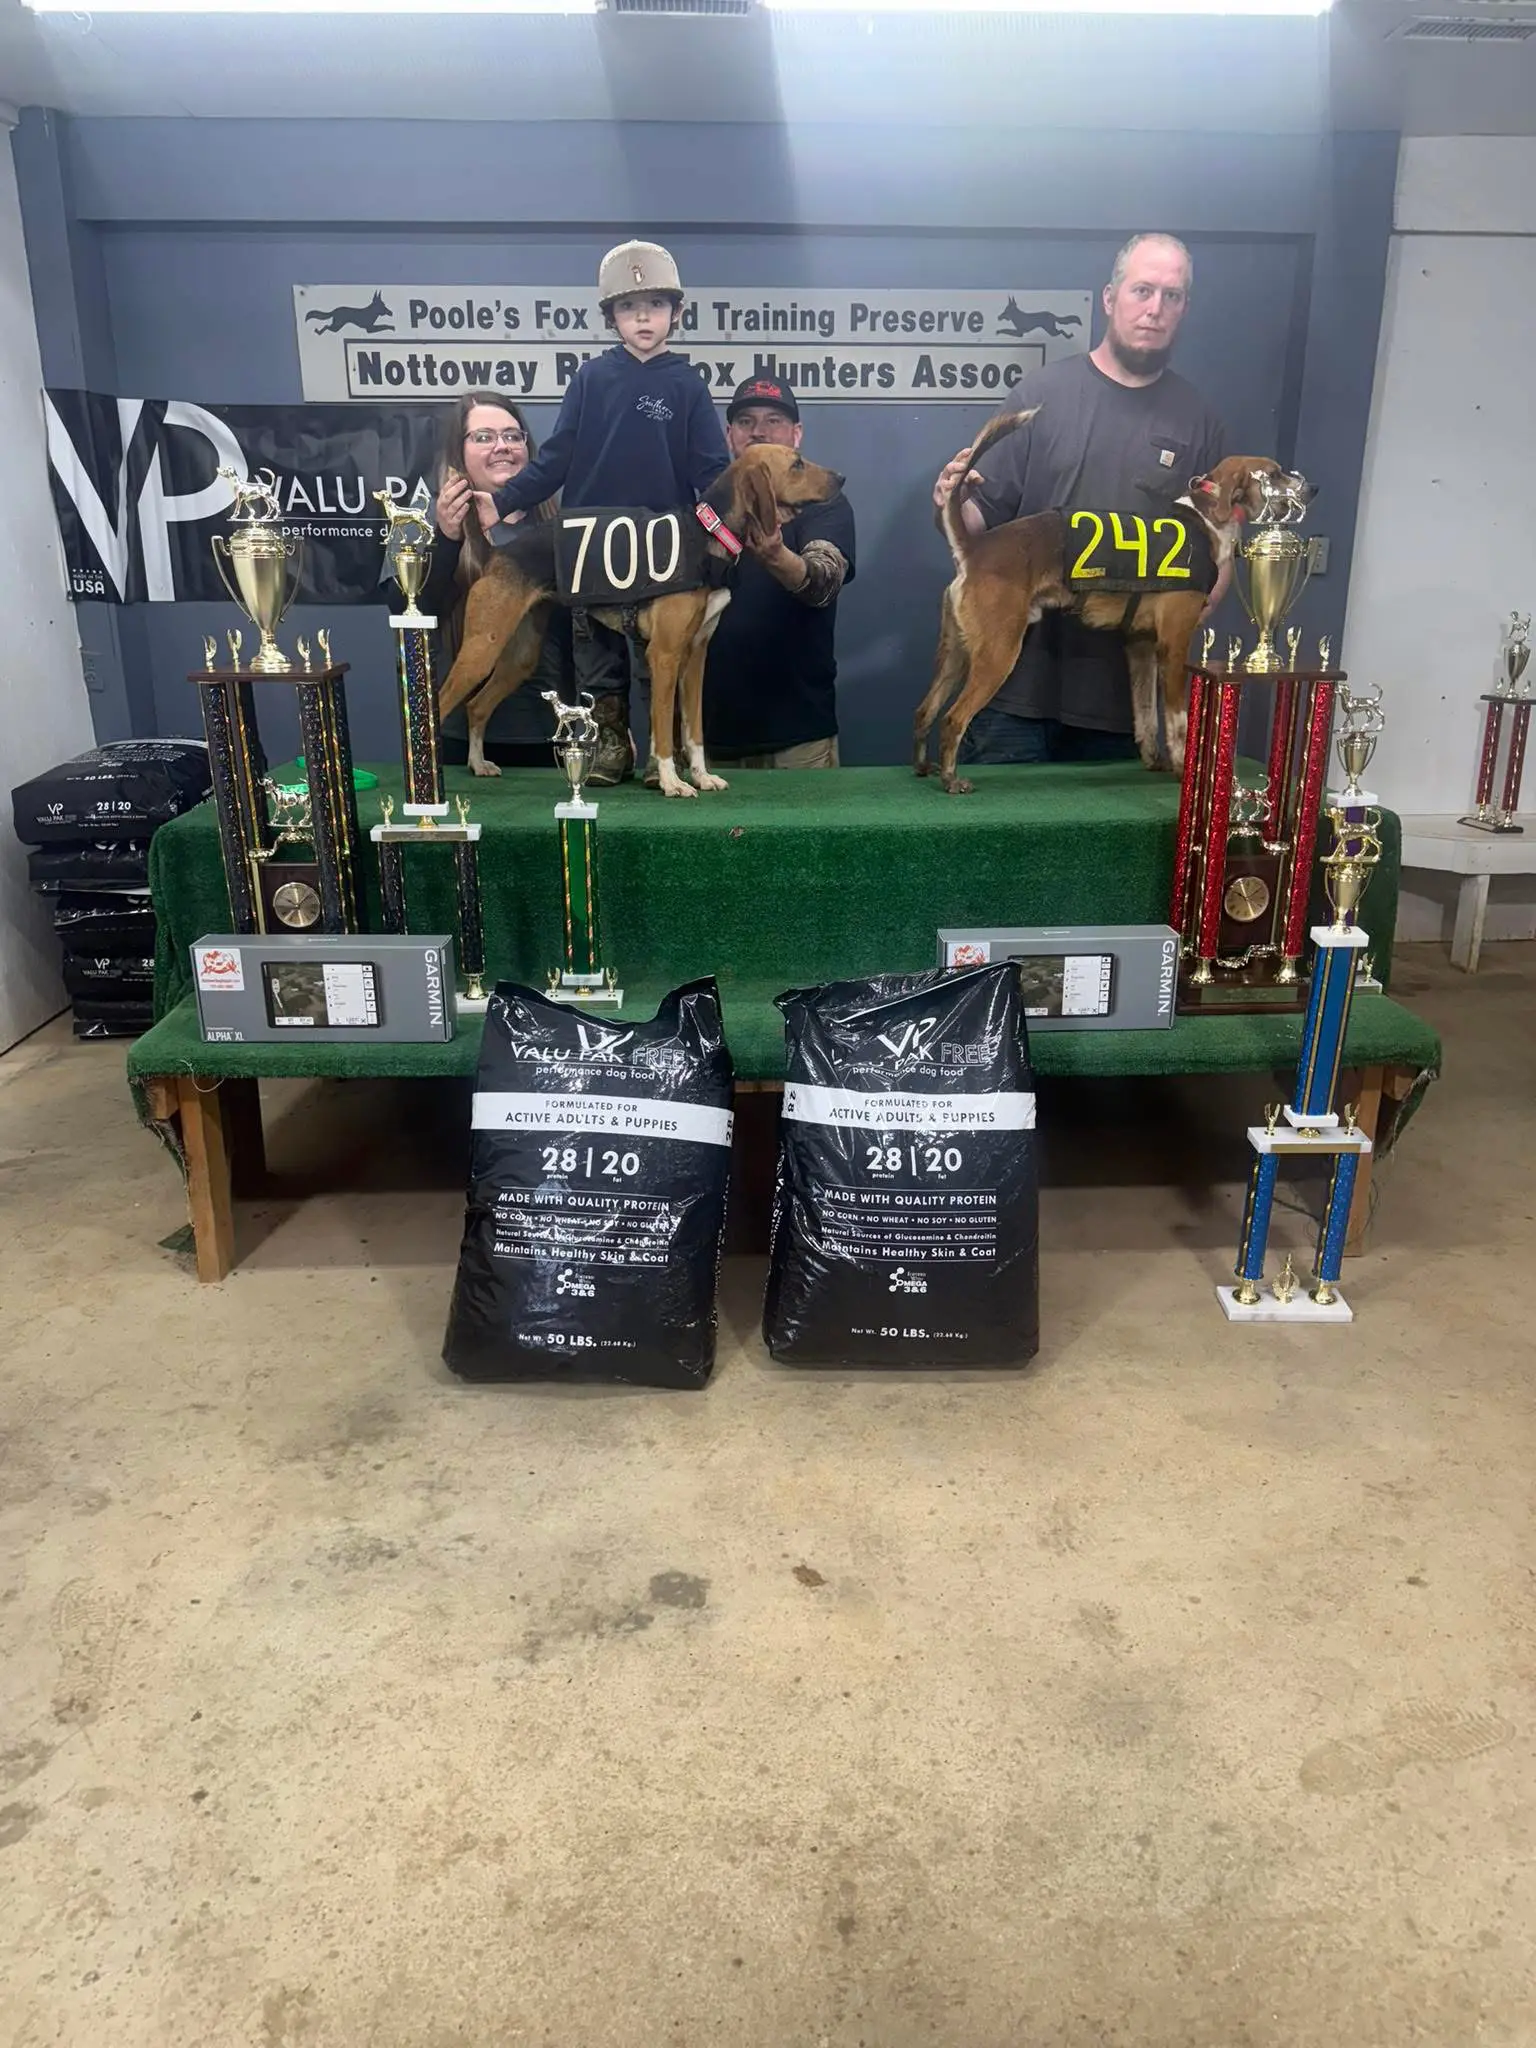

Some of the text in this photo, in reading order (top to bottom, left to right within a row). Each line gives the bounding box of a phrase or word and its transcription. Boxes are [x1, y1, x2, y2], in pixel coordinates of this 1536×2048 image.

[409, 299, 520, 330] Poole's
[536, 300, 588, 330] Fox
[713, 302, 835, 338] Training
[850, 303, 984, 333] Preserve
[357, 351, 538, 394] Nottoway
[911, 355, 1023, 389] Assoc
[385, 476, 432, 508] PA
[281, 523, 373, 538] performance
[1070, 511, 1191, 579] 242
[562, 514, 680, 594] 700
[73, 579, 105, 595] USA
[97, 802, 109, 811] 28
[118, 801, 131, 811] 20
[1157, 939, 1175, 1013] GARMIN
[424, 949, 443, 1025] GARMIN
[207, 1031, 245, 1041] ALPHA XL
[632, 1047, 686, 1070] FREE
[941, 1043, 989, 1064] FREE
[606, 1067, 627, 1080] dog
[631, 1069, 656, 1080] food
[919, 1066, 937, 1077] dog
[940, 1067, 964, 1077] food
[545, 1099, 638, 1112] FORMULATED FOR
[864, 1098, 953, 1109] FORMULATED FOR
[505, 1112, 678, 1131] ACTIVE ADULTS & PUPPIES
[829, 1107, 870, 1122] ACTIVE
[876, 1112, 923, 1123] ADULTS
[943, 1112, 996, 1123] PUPPIES
[541, 1146, 577, 1173] 28
[602, 1150, 640, 1176] 20
[866, 1147, 902, 1171] 28
[925, 1148, 962, 1172] 20
[498, 1192, 670, 1212] MADE WITH QUALITY PROTEIN
[824, 1189, 997, 1206] MADE WITH QUALITY PROTEIN
[495, 1212, 507, 1220] NO
[627, 1221, 638, 1229] NO
[822, 1209, 834, 1218] NO
[837, 1211, 858, 1221] CORN
[866, 1215, 879, 1223] NO
[882, 1215, 909, 1224] WHEAT
[917, 1216, 930, 1224] NO
[932, 1216, 947, 1224] SOY
[968, 1216, 997, 1224] GLUTEN
[495, 1228, 521, 1237] Natural
[821, 1226, 849, 1237] Natural
[851, 1230, 881, 1239] Sources
[884, 1232, 892, 1240] of
[895, 1233, 944, 1241] Glucosamine
[494, 1242, 547, 1256] Maintains
[551, 1246, 597, 1262] Healthy
[600, 1251, 625, 1263] Skin
[642, 1253, 669, 1263] Coat
[822, 1241, 996, 1259] Maintains Healthy Skin & Coat
[564, 1281, 596, 1290] OMEGA
[896, 1279, 928, 1287] OMEGA
[571, 1289, 596, 1297] 3&6
[519, 1333, 532, 1341] Net
[547, 1333, 565, 1345] 50
[570, 1335, 597, 1347] LBS.
[880, 1327, 898, 1337] 50
[903, 1328, 930, 1338] LBS.
